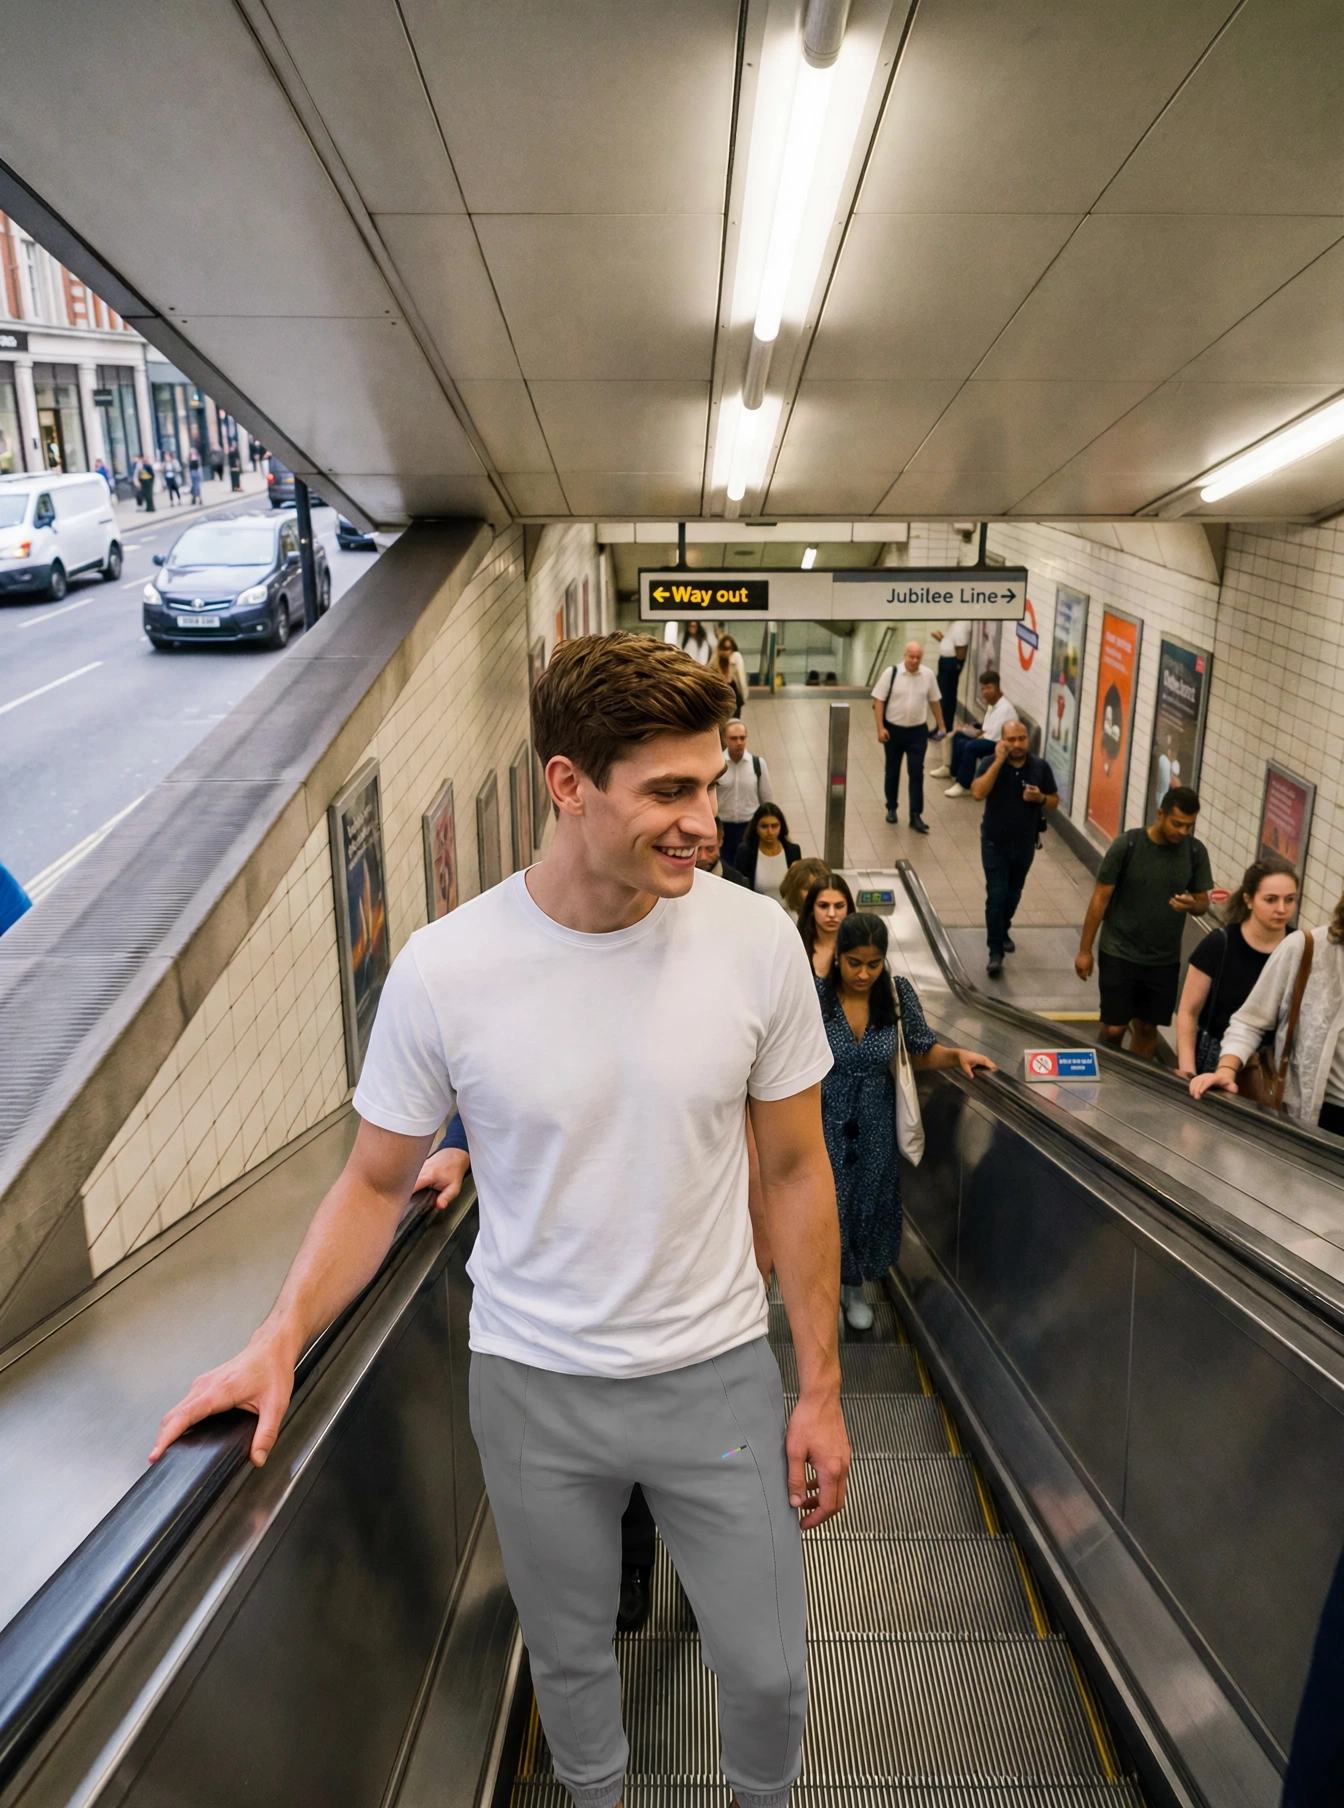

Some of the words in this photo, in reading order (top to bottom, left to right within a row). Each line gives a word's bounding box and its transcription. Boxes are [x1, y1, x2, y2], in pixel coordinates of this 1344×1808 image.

[671, 586, 713, 607] Way
[716, 587, 749, 603] out
[886, 587, 954, 604] Jubilee
[960, 587, 998, 604] Line
